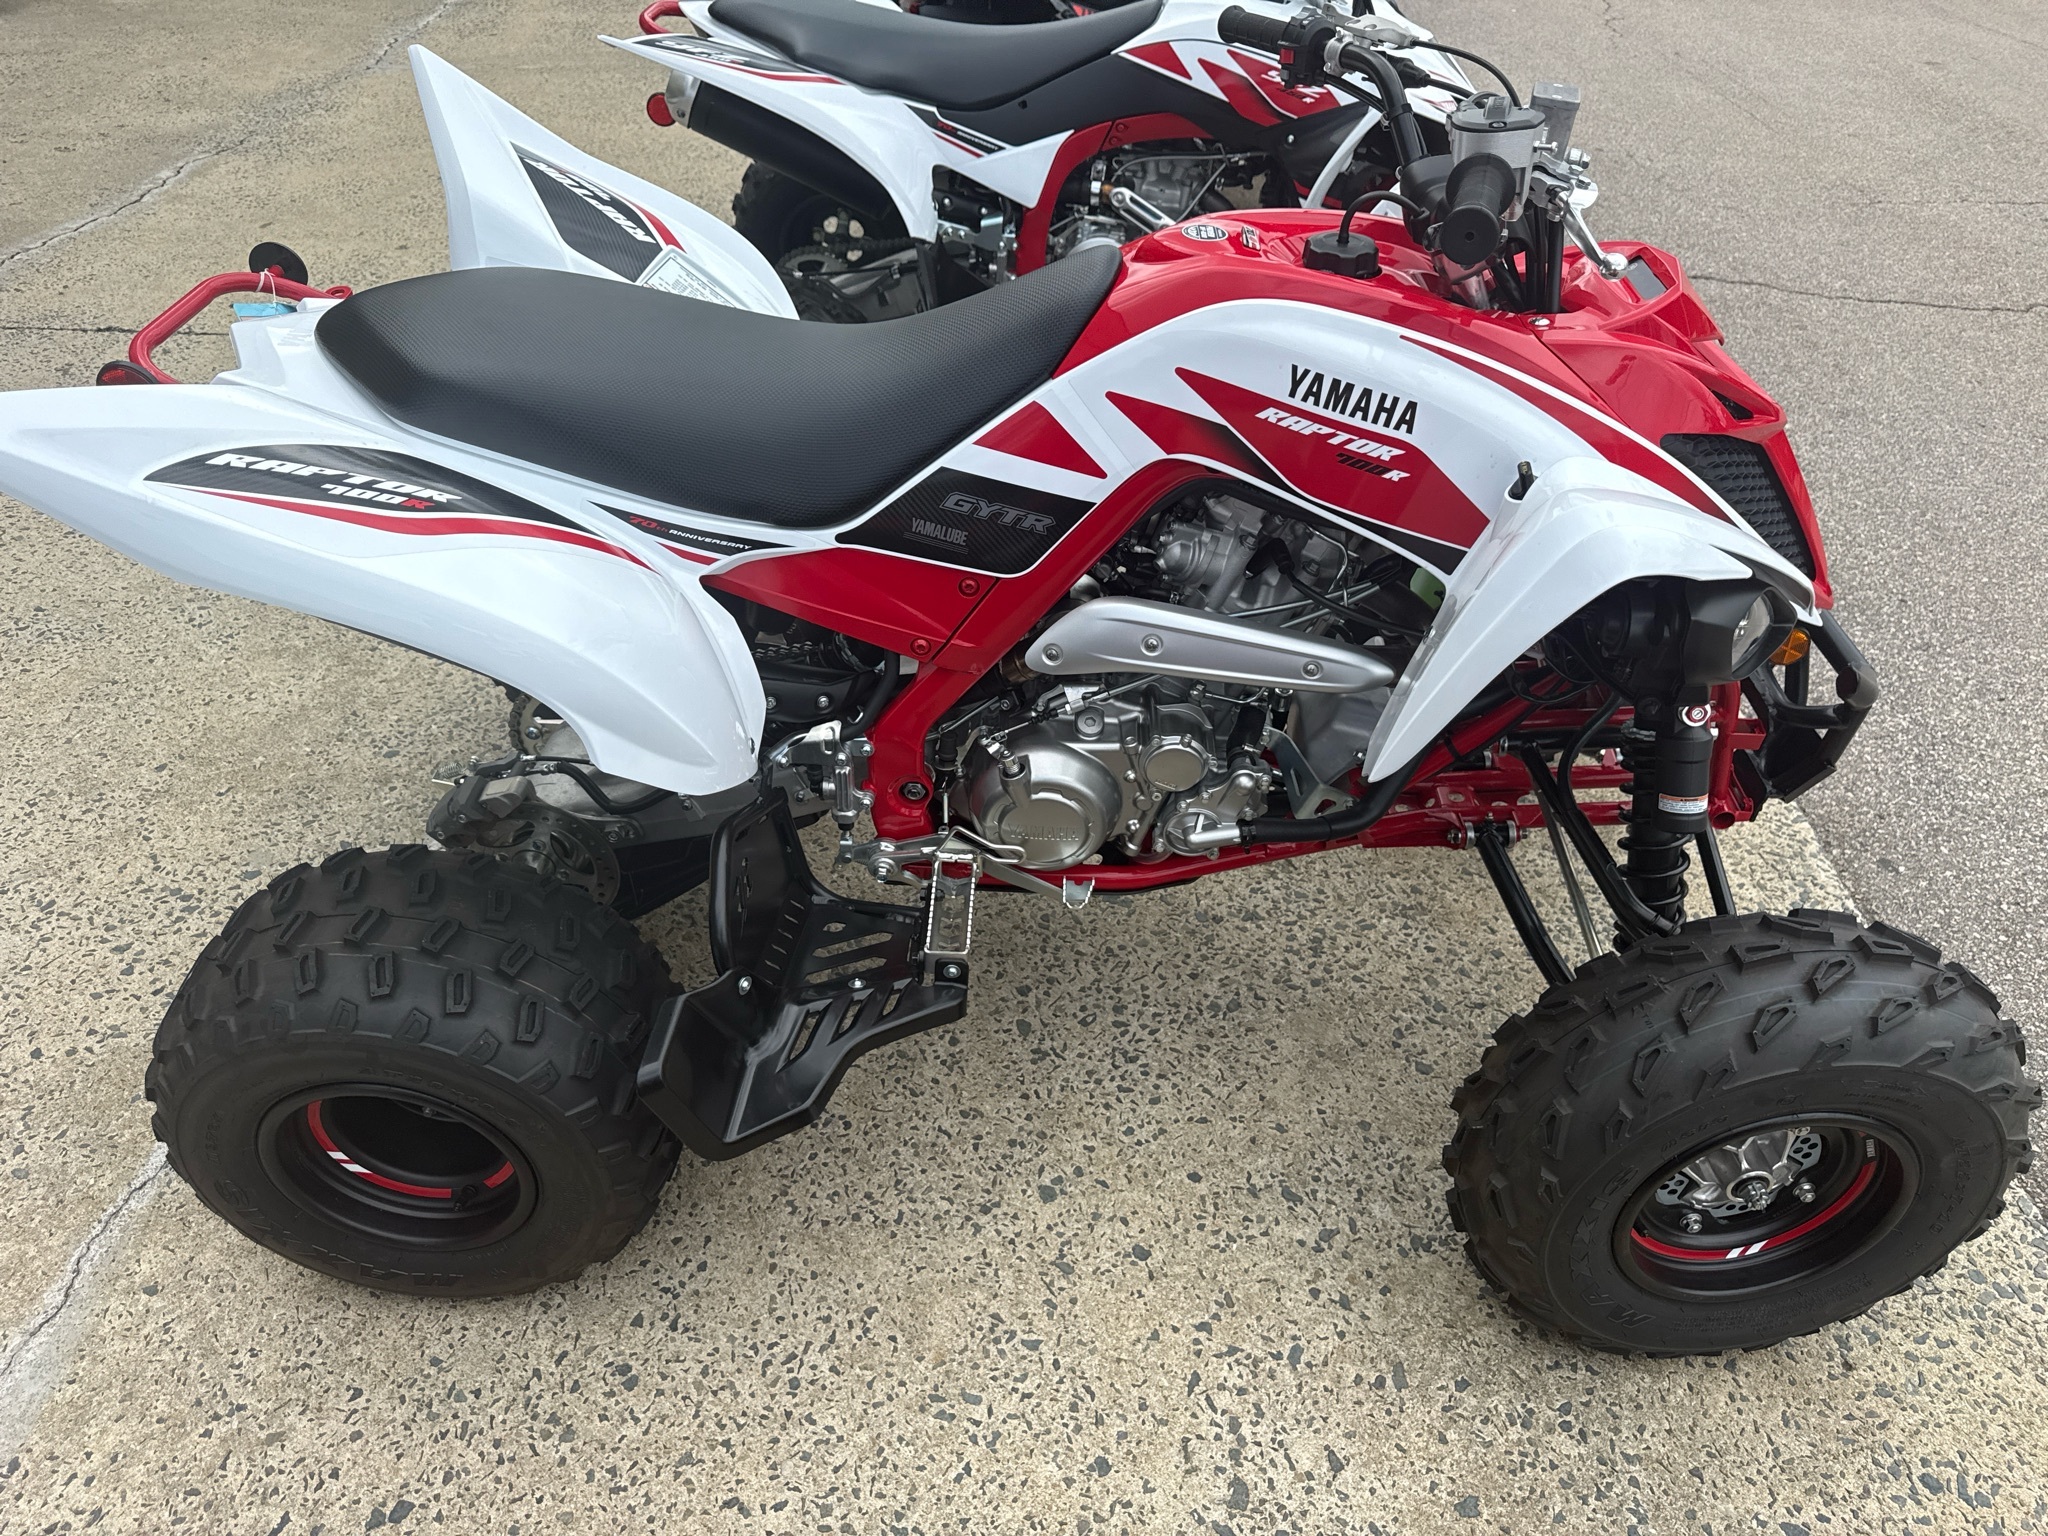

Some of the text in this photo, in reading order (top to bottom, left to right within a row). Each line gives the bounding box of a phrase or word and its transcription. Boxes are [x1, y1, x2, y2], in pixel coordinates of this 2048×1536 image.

[524, 158, 657, 244] RAPTOR
[1288, 363, 1418, 435] YAMAHA
[1254, 406, 1406, 462] RAPTOR
[205, 452, 463, 504] RAPTOR
[1335, 452, 1411, 482] 700R
[320, 483, 435, 510] 700R
[940, 491, 1056, 535] GYTR
[668, 529, 752, 550] ANNIVERSARY
[911, 517, 969, 546] YAMALUBE
[1007, 823, 1079, 841] YAMAHA
[1569, 1163, 1656, 1328] MAXXIS
